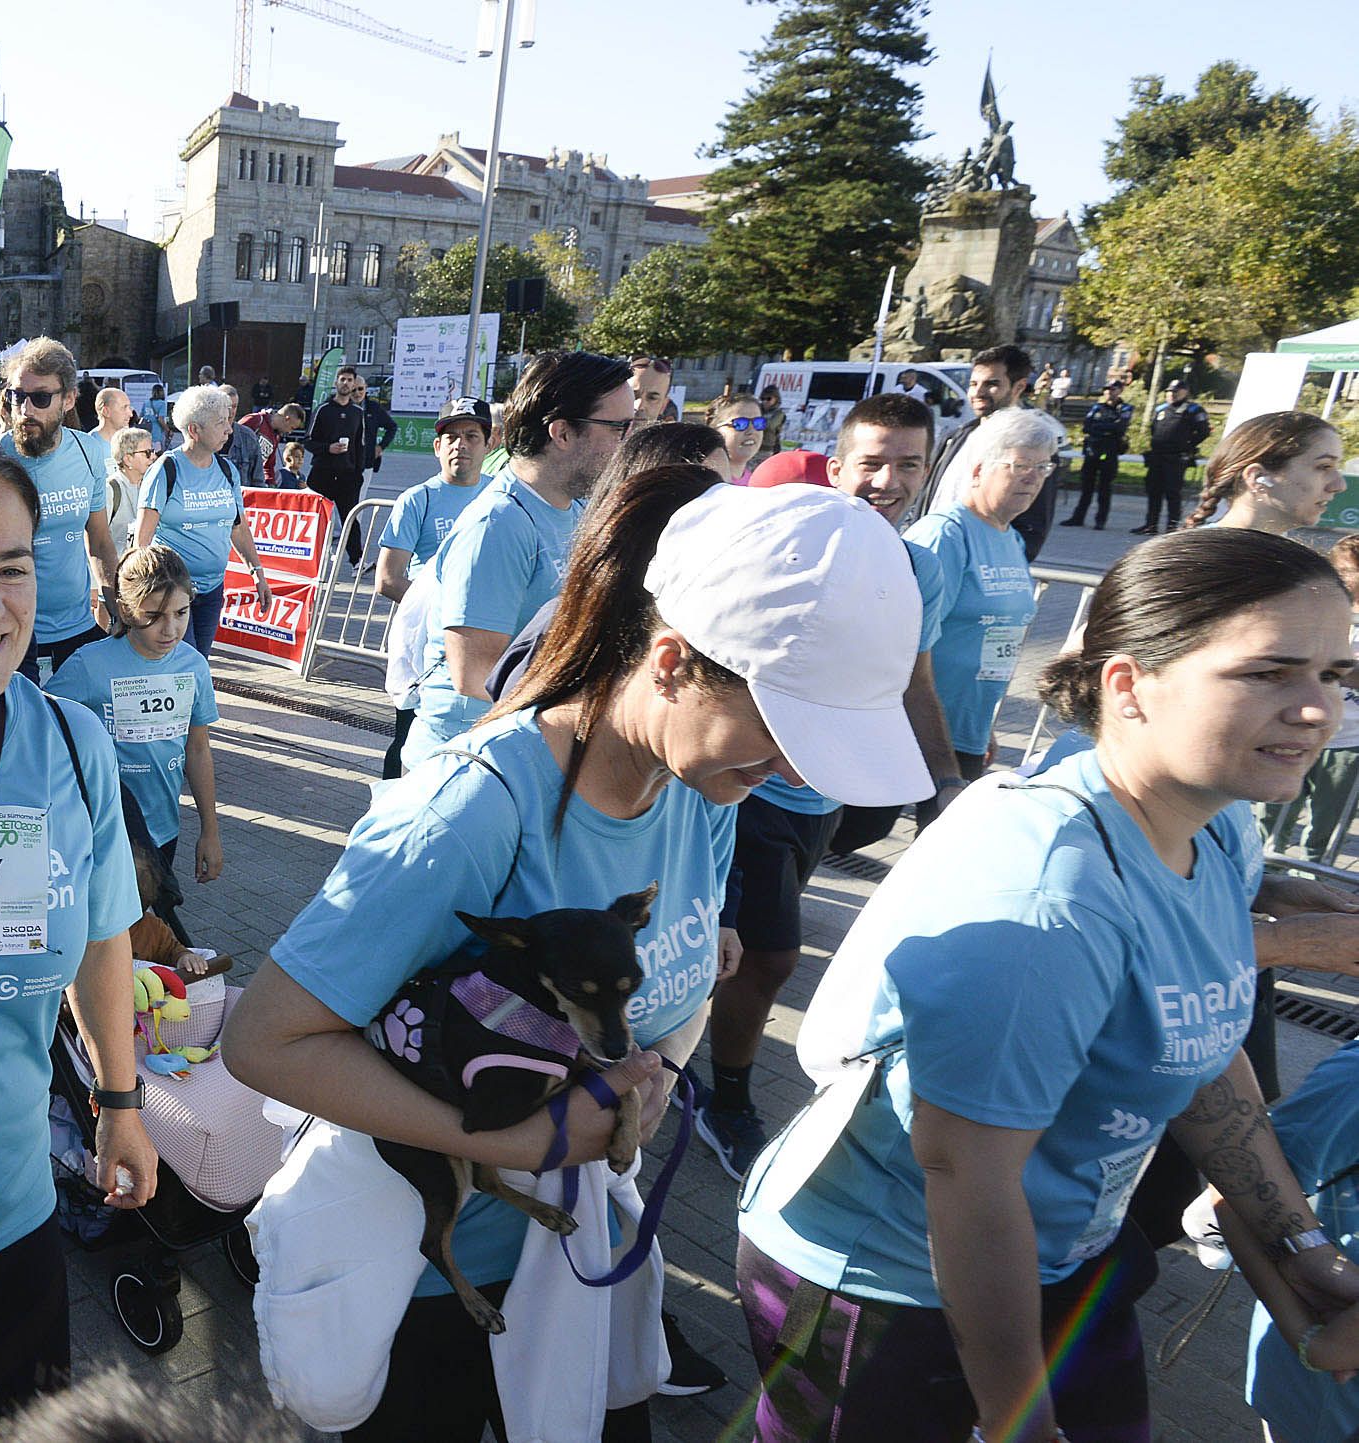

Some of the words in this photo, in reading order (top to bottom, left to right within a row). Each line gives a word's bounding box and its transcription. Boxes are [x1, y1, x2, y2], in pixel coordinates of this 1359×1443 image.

[763, 373, 804, 392] DANNA
[183, 489, 197, 501] En
[245, 508, 316, 544] FROIZ
[434, 517, 454, 531] En
[225, 591, 300, 630] FROIZ
[113, 678, 149, 686] Pontevedra
[114, 691, 129, 699] pola
[139, 696, 175, 714] 120
[1154, 984, 1204, 1029] En
